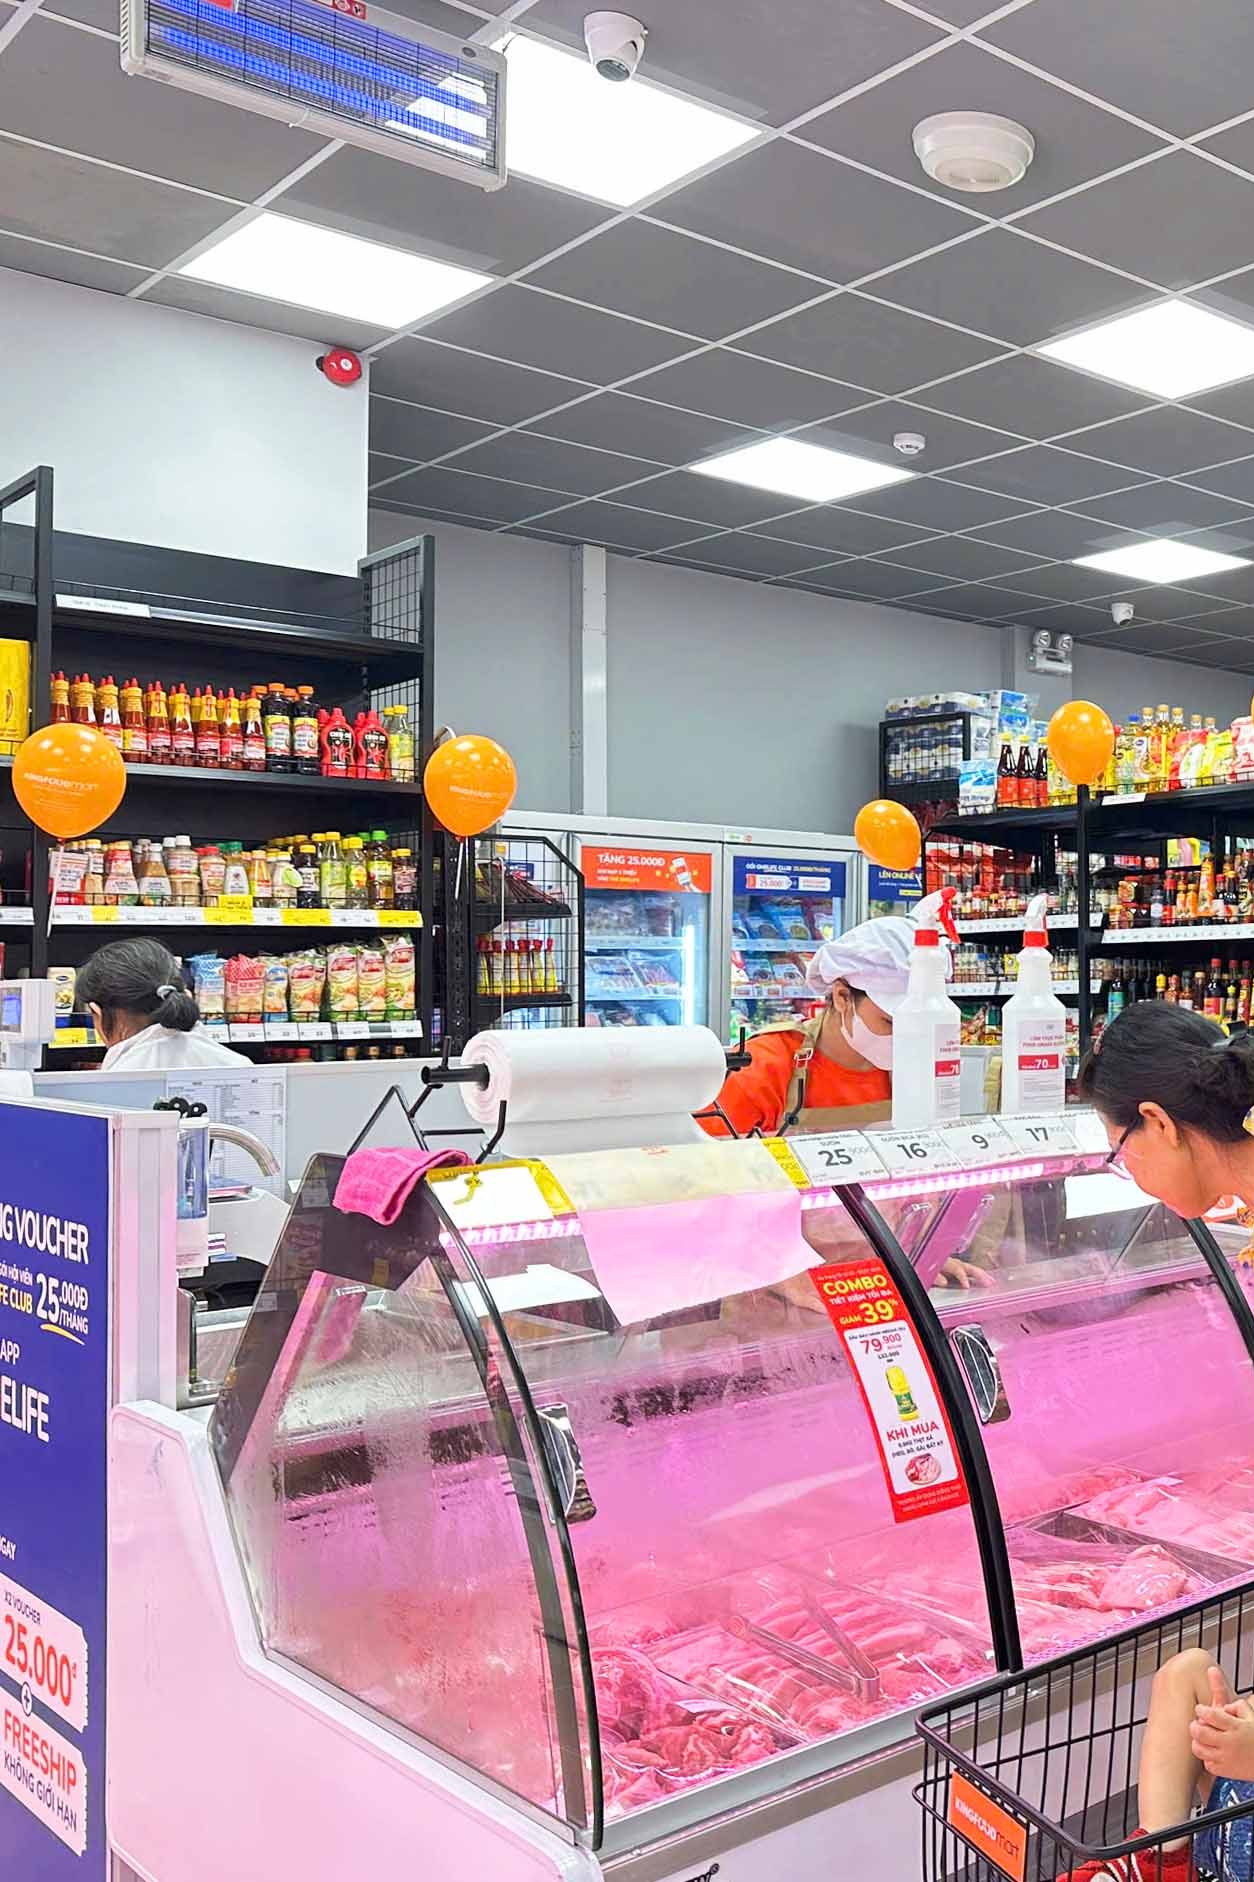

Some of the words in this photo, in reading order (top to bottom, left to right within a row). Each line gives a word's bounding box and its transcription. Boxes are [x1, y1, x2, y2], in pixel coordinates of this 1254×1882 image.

[14, 1206, 89, 1265] VOUCHER
[823, 1274, 888, 1296] COMBO
[10, 1287, 33, 1314] CLUB
[59, 1308, 89, 1334] /THÁNG
[0, 1338, 20, 1365] APP
[887, 1427, 909, 1442] KHI
[911, 1421, 940, 1437] MUA
[0, 1534, 16, 1561] GAY
[4, 1708, 77, 1795] FREESHIP
[4, 1749, 35, 1793] KHÔNG
[36, 1779, 55, 1812] GIỚI
[57, 1798, 77, 1833] HẠN
